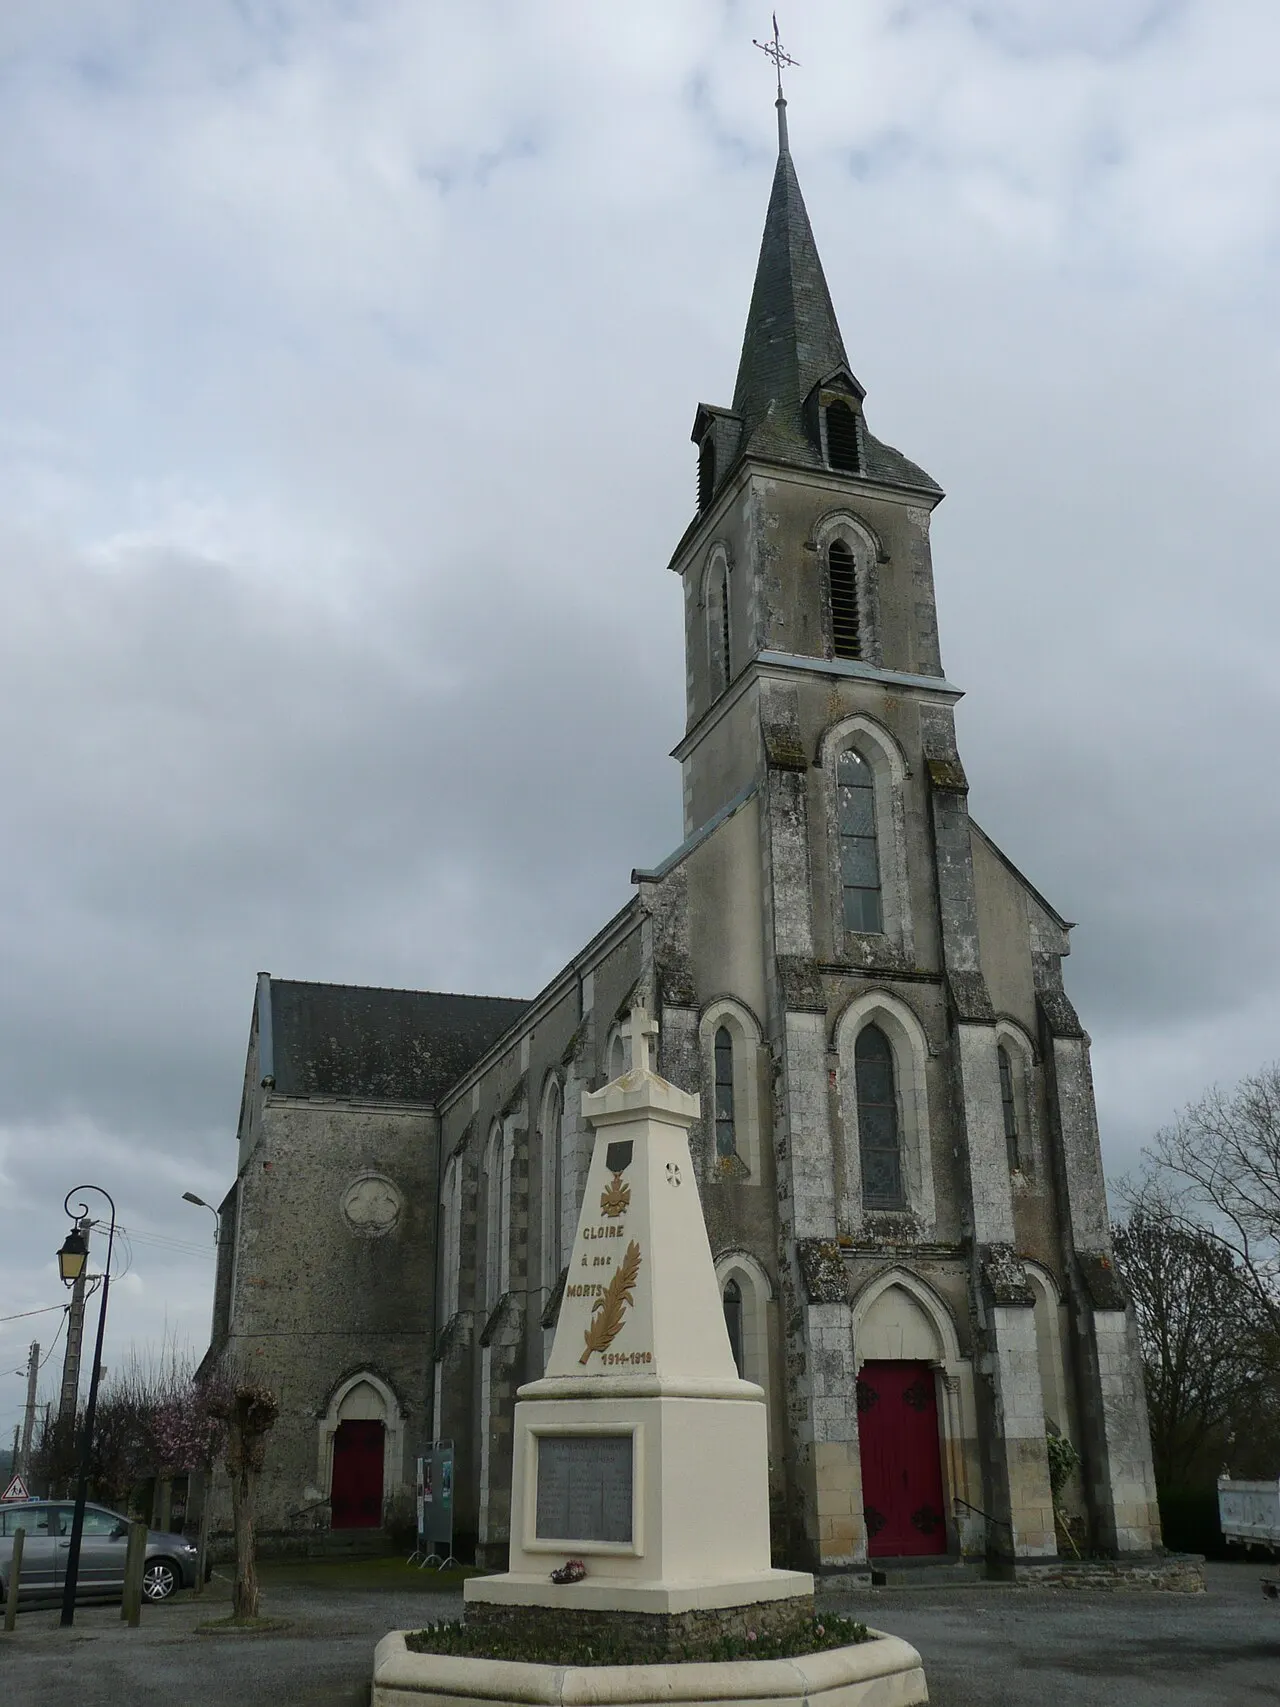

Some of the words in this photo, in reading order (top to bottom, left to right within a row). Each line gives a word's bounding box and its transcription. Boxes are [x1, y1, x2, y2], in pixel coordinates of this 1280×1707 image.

[583, 1225, 624, 1240] GLOIRE
[593, 1255, 612, 1267] nos
[567, 1284, 603, 1298] MORTS
[601, 1351, 653, 1366] 1914-1918
